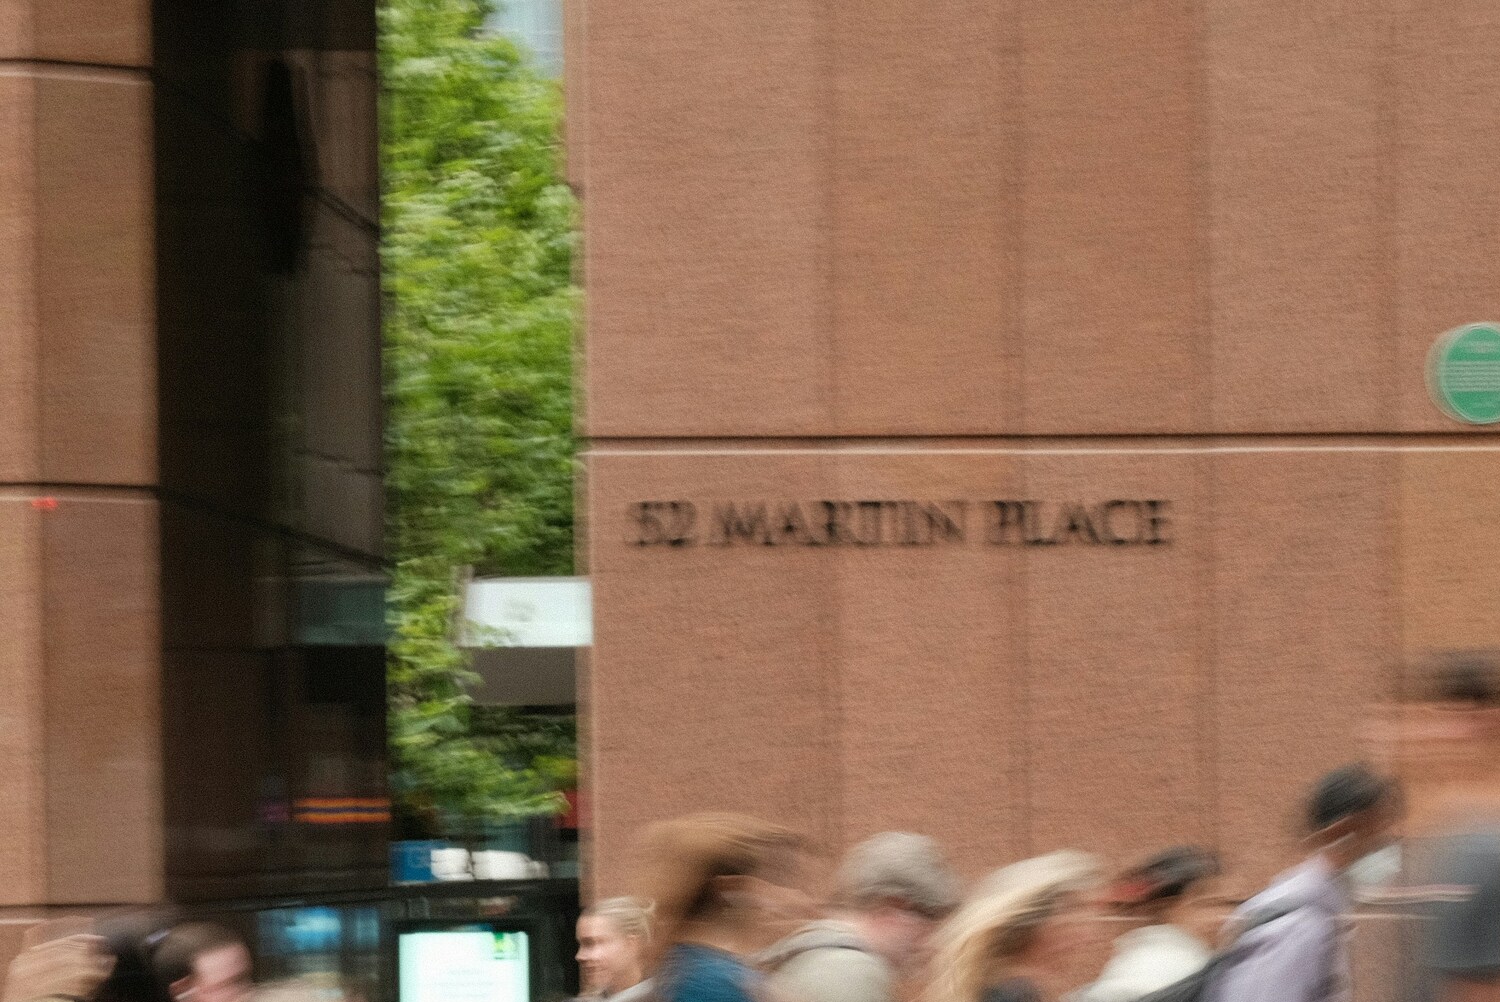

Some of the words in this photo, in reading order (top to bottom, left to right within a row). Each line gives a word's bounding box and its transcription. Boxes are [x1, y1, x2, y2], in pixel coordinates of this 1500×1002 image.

[627, 500, 698, 548] 52
[705, 500, 968, 548] MARTIN
[986, 500, 1171, 548] PLACE
